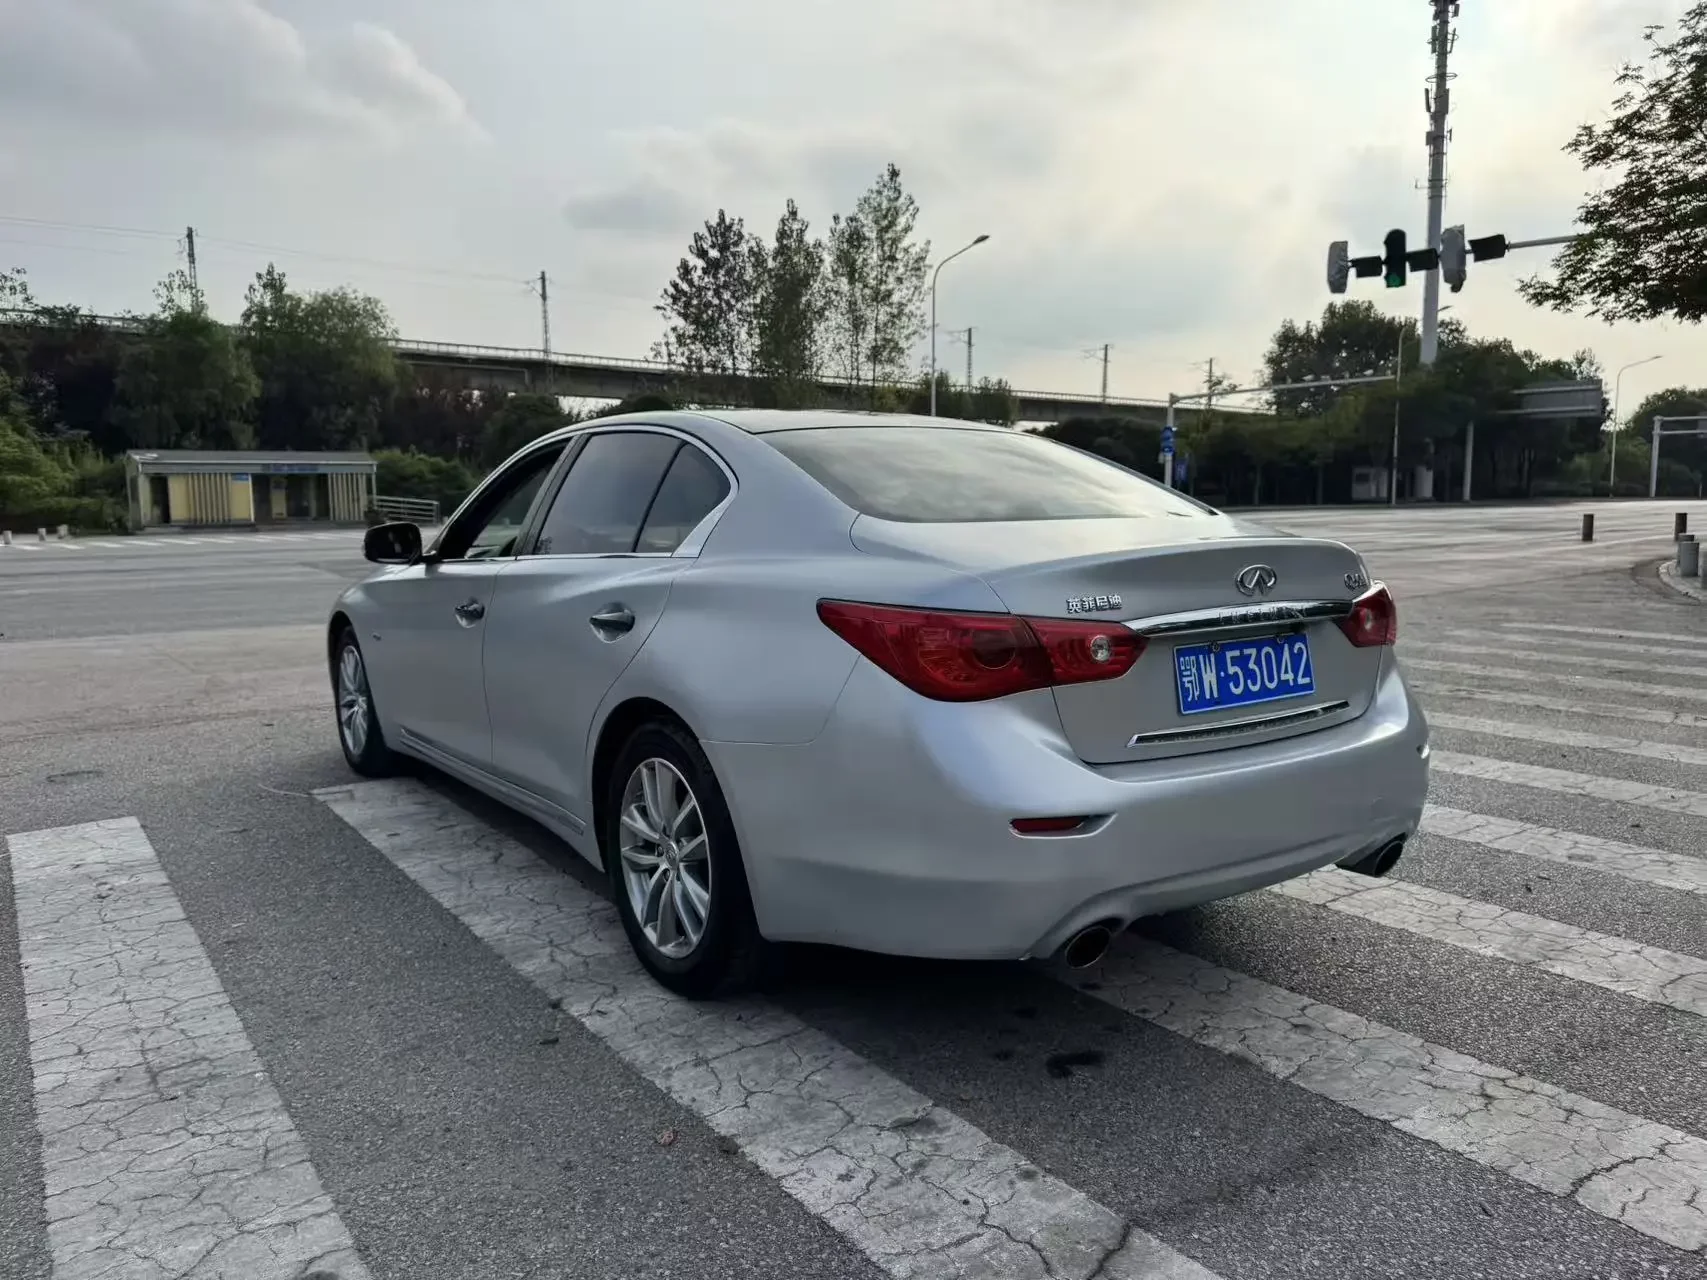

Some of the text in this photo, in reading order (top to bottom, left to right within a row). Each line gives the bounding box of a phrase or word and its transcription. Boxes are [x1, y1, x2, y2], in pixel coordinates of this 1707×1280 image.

[1066, 595, 1122, 613] 英菲尼迪
[1180, 642, 1311, 702] 鄂W·53042
